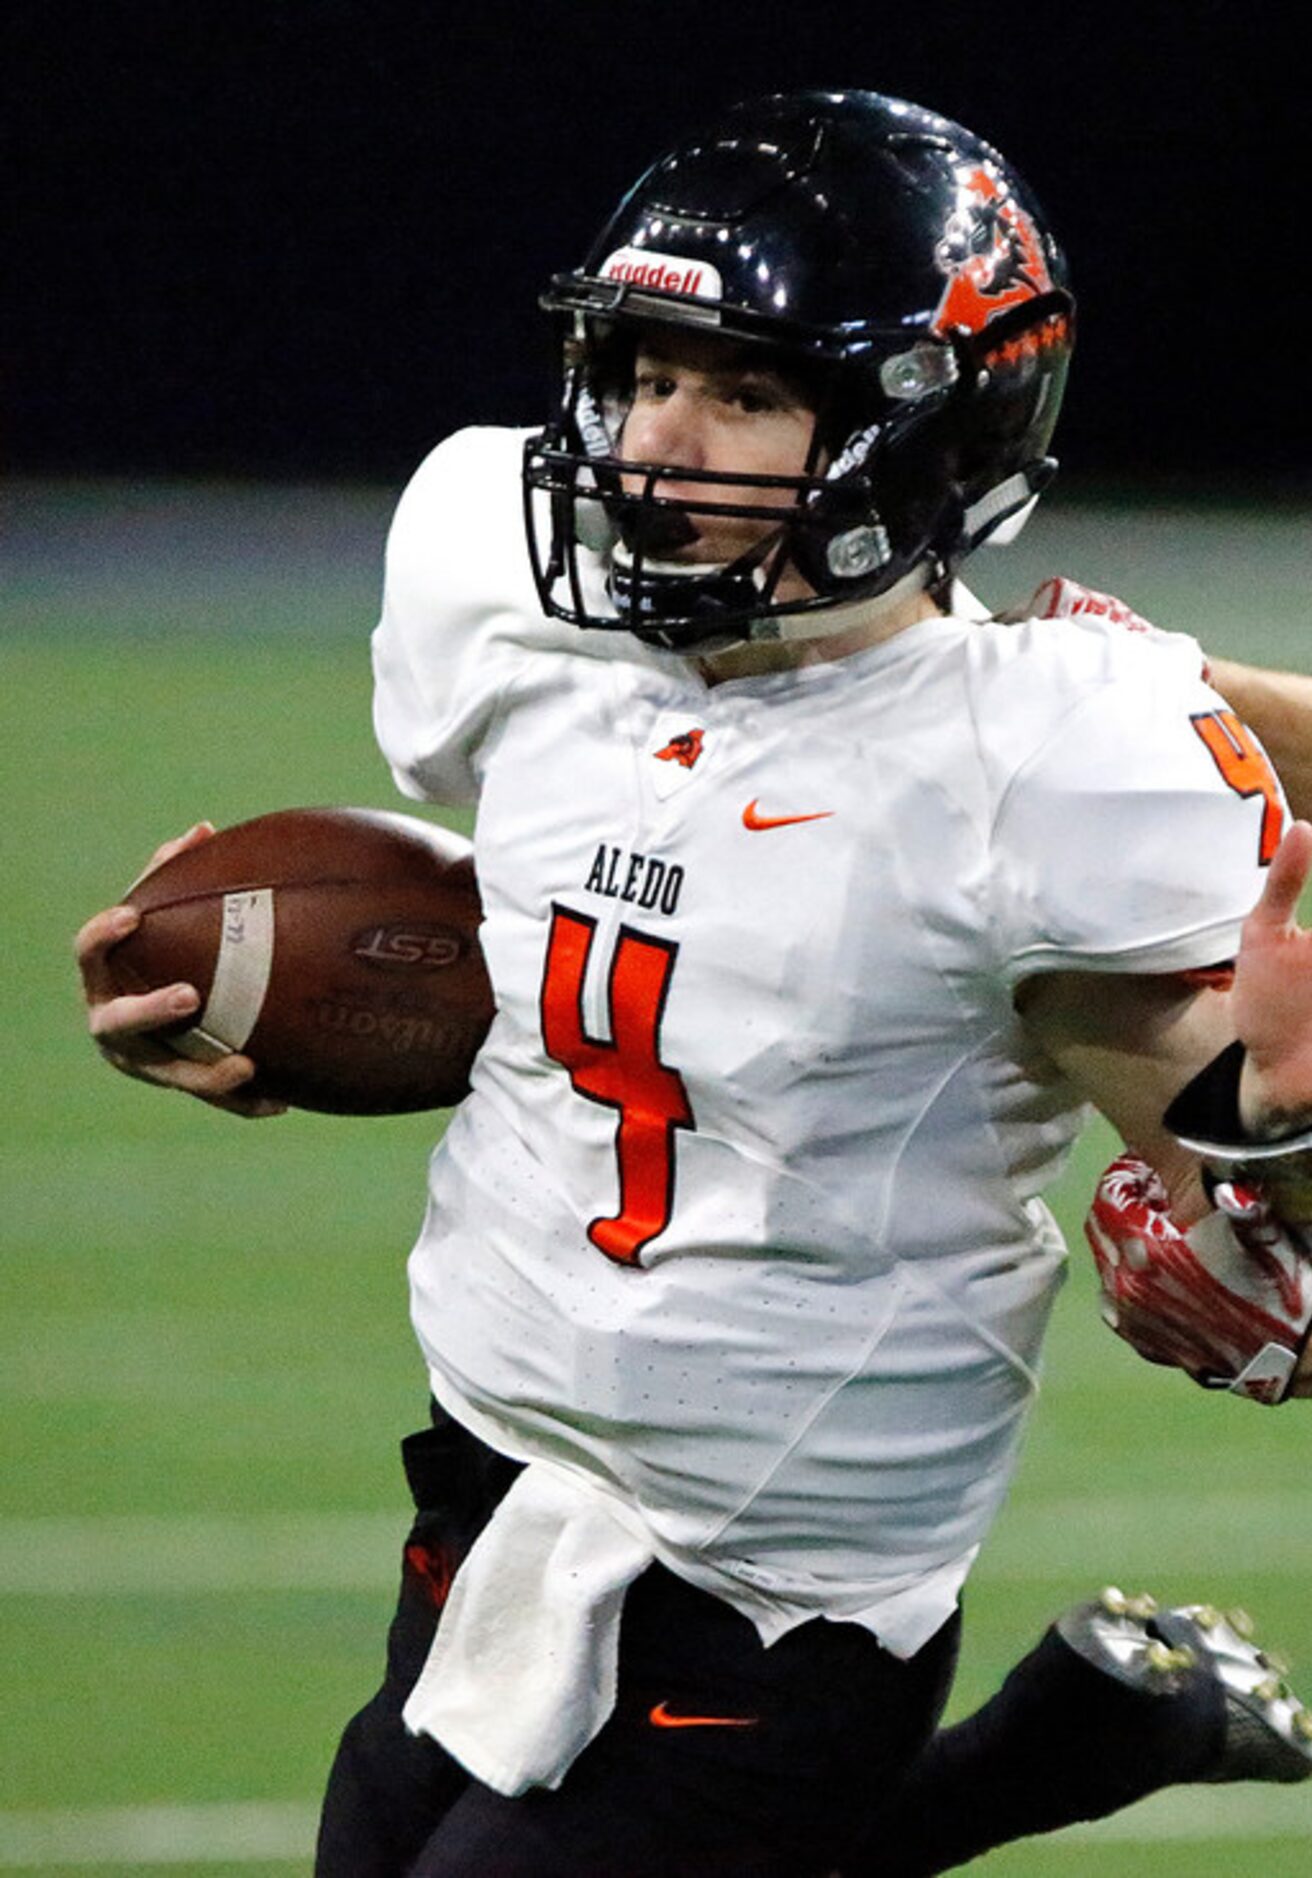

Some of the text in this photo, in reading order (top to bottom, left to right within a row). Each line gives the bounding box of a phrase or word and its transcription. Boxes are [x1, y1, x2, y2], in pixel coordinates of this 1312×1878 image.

[1188, 708, 1285, 868] 4
[584, 842, 685, 916] ALEDO
[353, 928, 460, 966] GST
[539, 900, 698, 1269] 4
